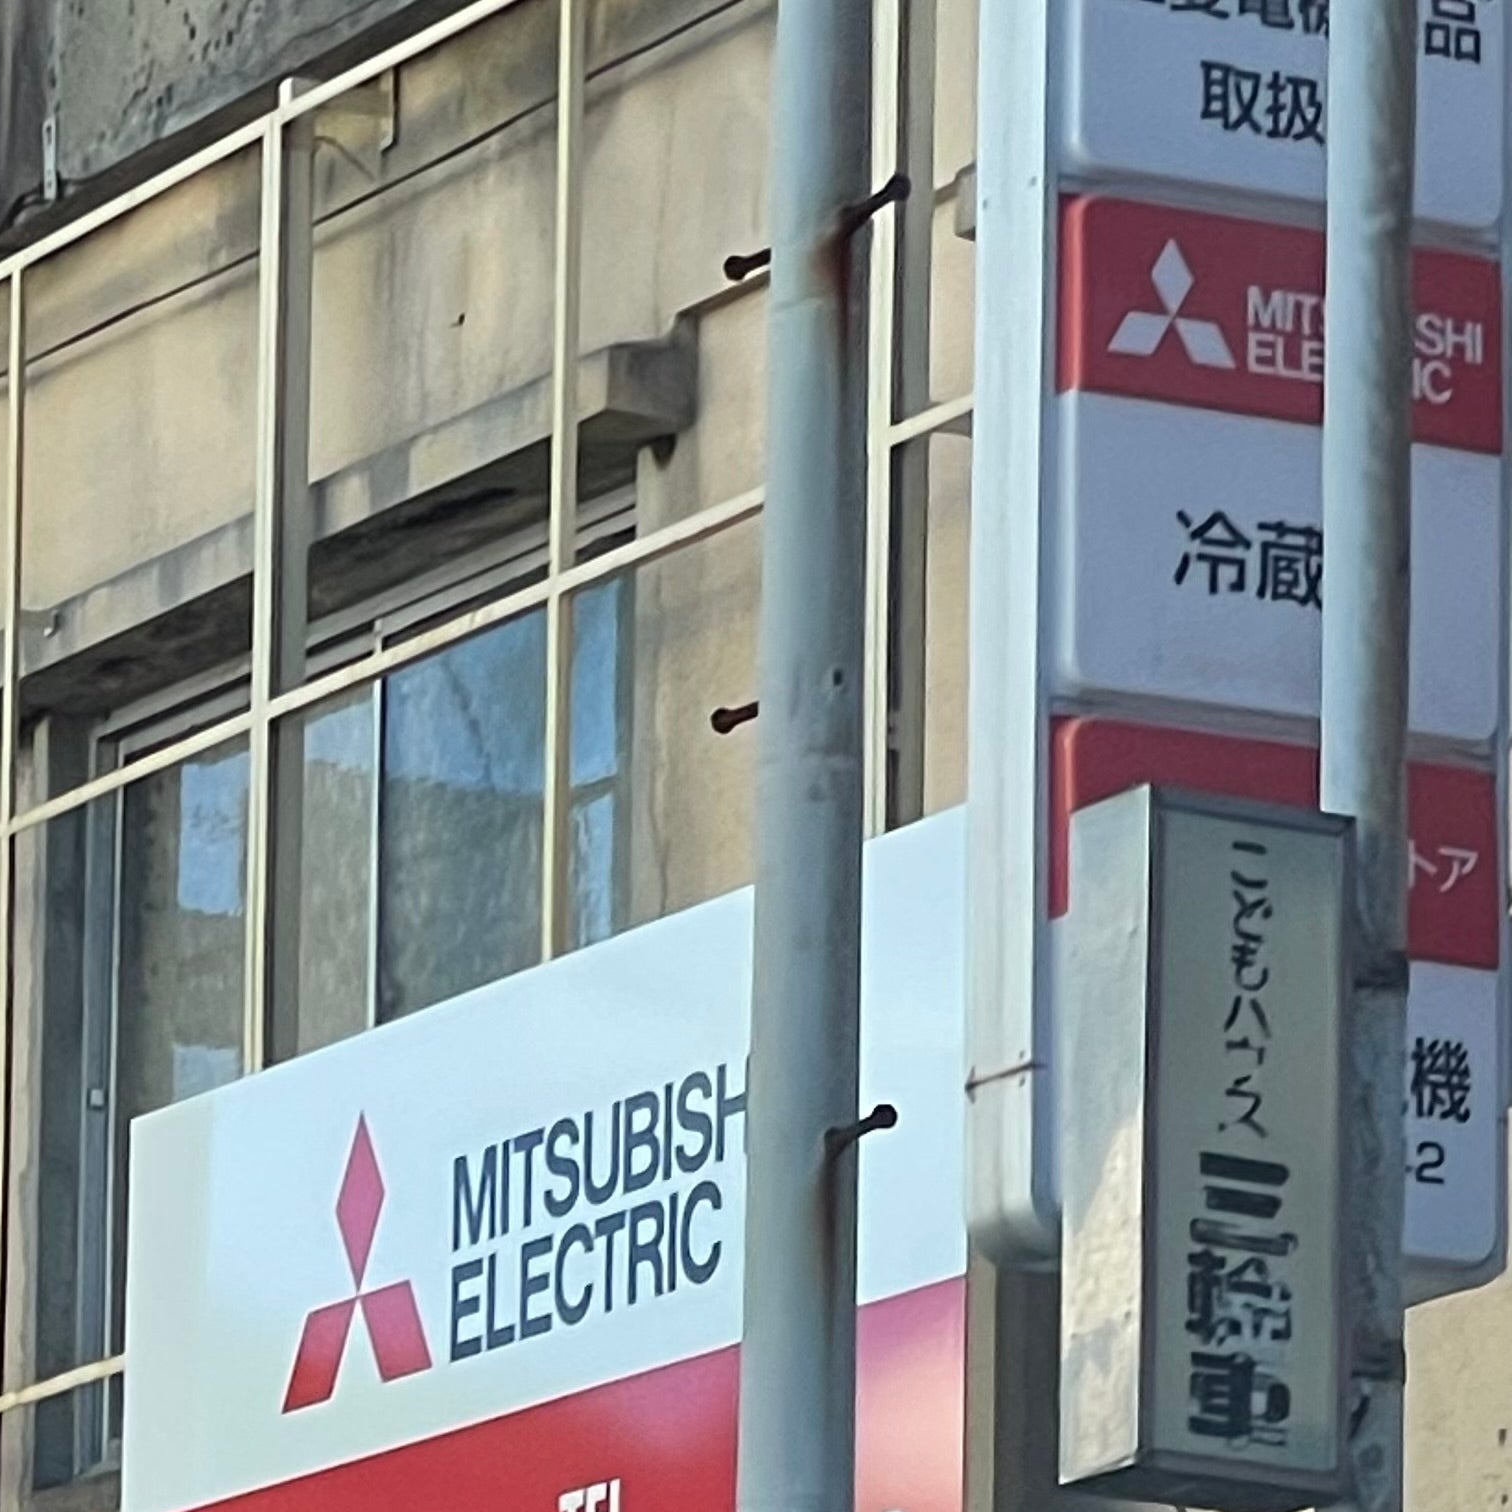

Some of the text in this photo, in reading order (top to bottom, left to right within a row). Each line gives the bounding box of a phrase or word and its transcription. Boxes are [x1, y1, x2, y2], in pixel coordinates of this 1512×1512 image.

[1199, 60, 1326, 144] 取扱
[1245, 285, 1484, 364] MITSHI
[1245, 332, 1454, 406] ELEIC
[1173, 509, 1324, 608] 冷蔵
[450, 1055, 751, 1251] MITSUBISH
[449, 1180, 724, 1364] ELECTRIC
